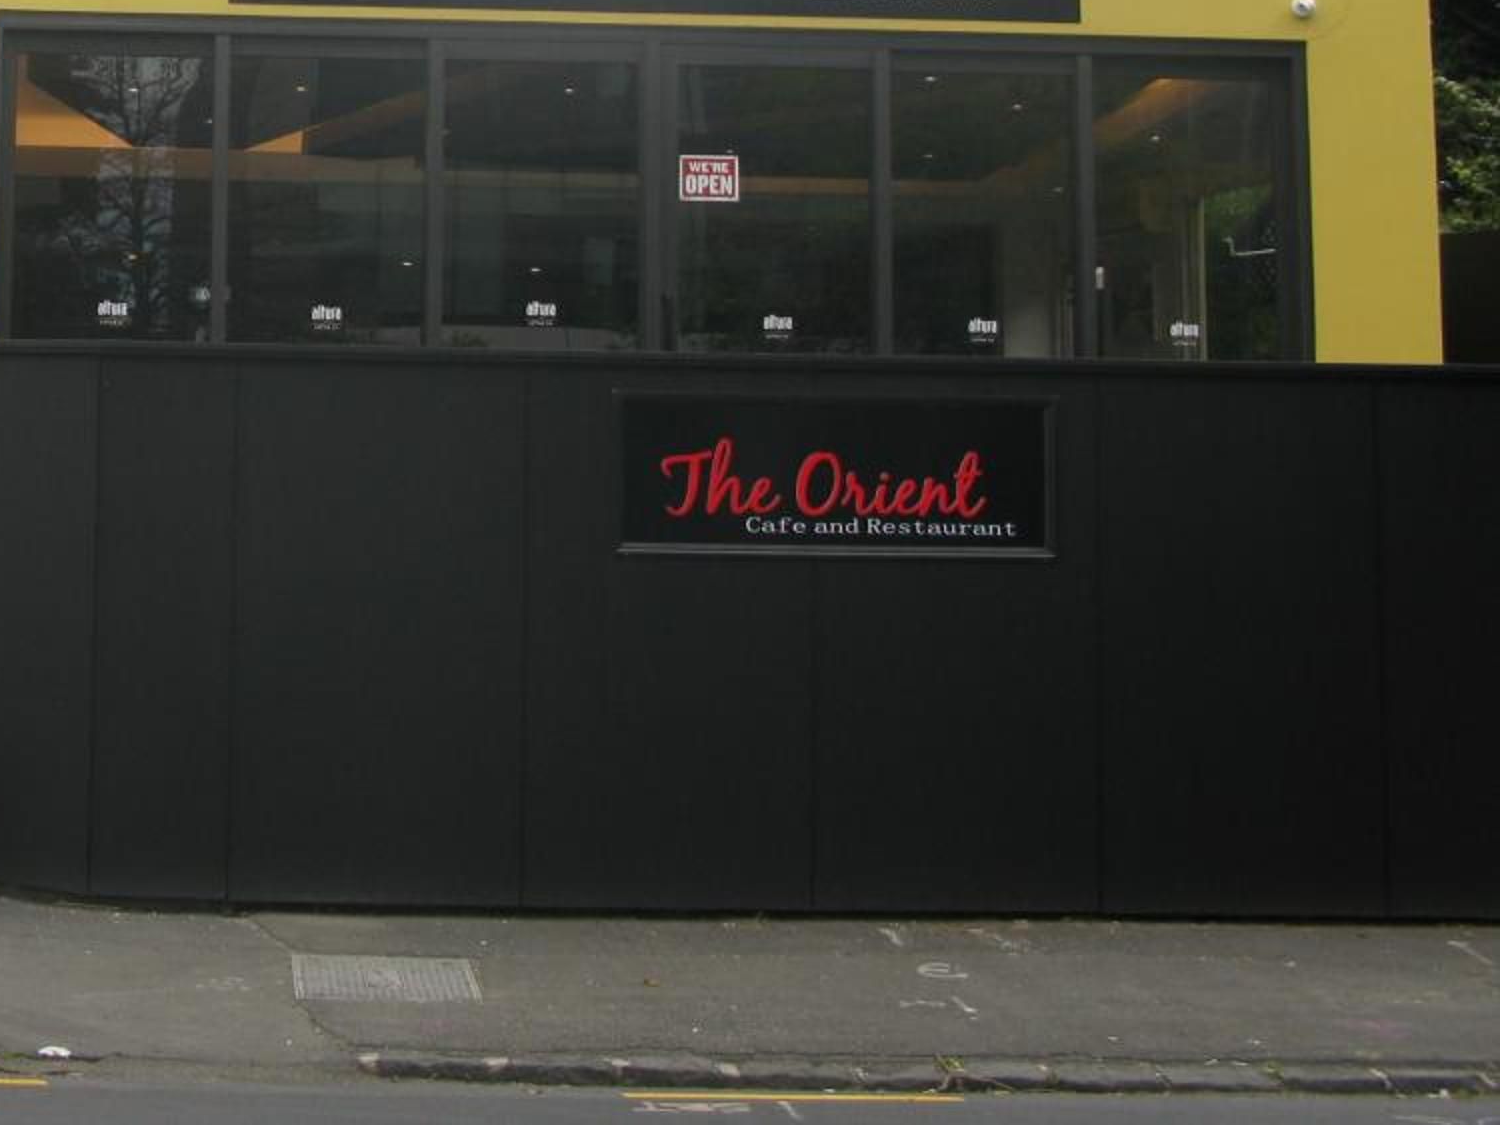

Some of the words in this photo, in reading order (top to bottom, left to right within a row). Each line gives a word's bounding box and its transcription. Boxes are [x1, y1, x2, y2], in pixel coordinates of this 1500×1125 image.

[685, 174, 734, 195] OPEN
[660, 437, 782, 517] The
[794, 450, 986, 519] Orient
[745, 516, 807, 535] Cafe
[814, 518, 859, 535] and
[867, 518, 1017, 537] Restaurant
